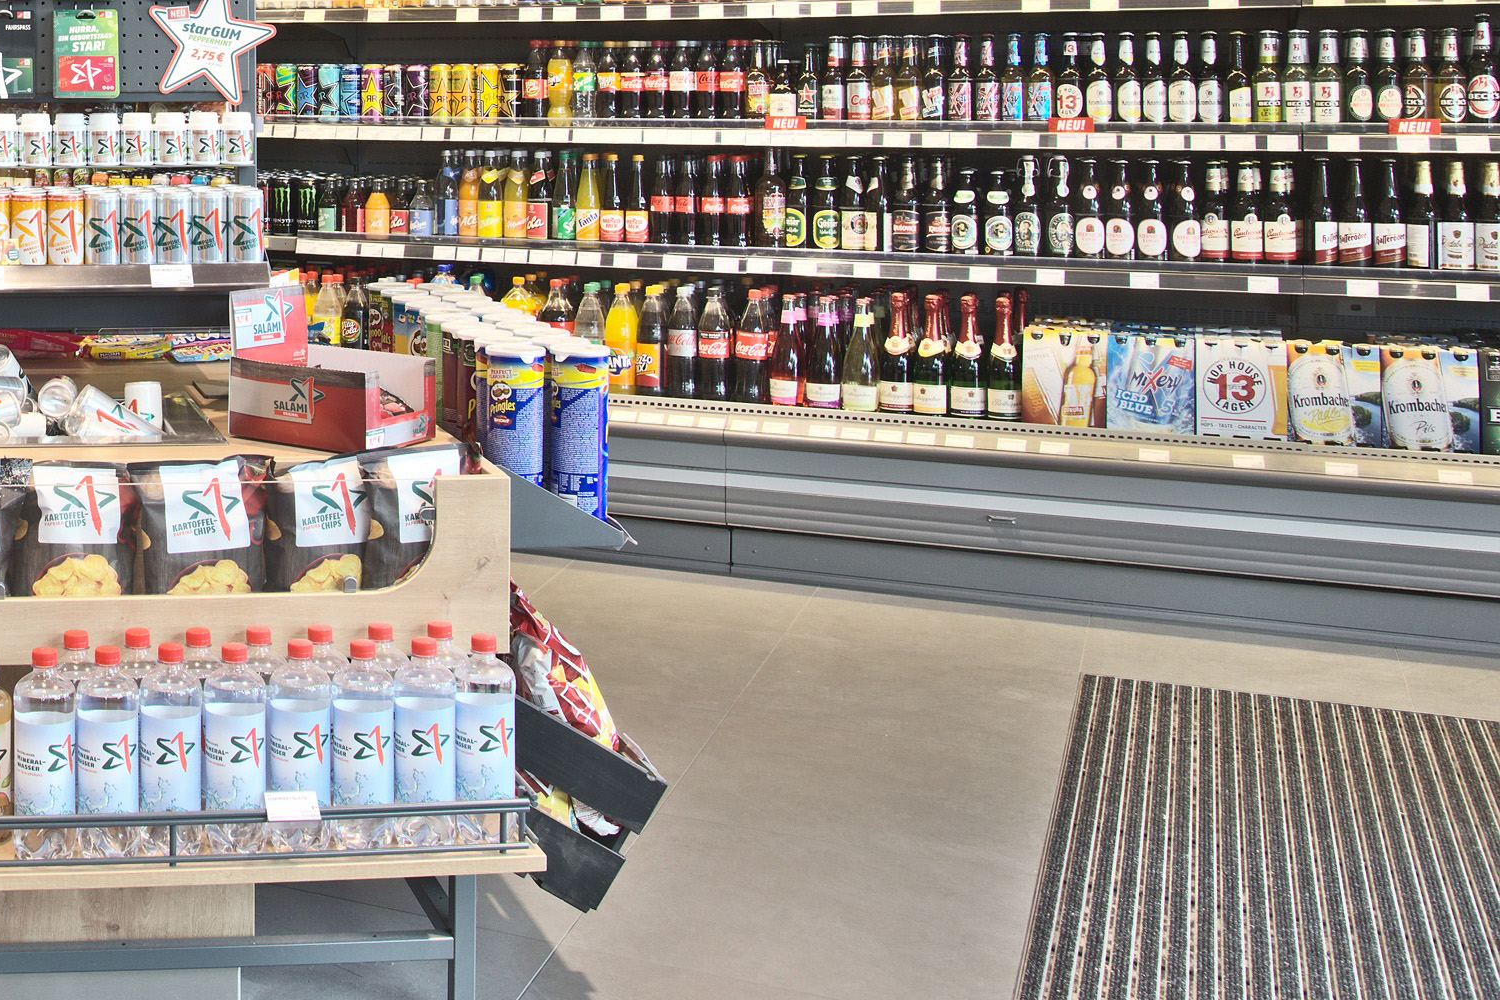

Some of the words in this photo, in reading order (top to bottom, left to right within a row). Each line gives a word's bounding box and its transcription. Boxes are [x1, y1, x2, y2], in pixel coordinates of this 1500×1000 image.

[170, 8, 186, 18] NEU
[69, 25, 99, 35] HURRA,
[181, 22, 242, 41] starGUM
[69, 33, 115, 42] GEBURTSTAGS-
[187, 34, 233, 48] PEPPERMINT
[71, 41, 106, 53] STAR!
[1063, 44, 1075, 53] 13
[190, 48, 216, 61] 2,75
[620, 78, 644, 89] oca-Cola
[1057, 93, 1077, 110] 13
[1468, 91, 1500, 101] BECK'S
[1056, 119, 1086, 131] NEU!
[1398, 121, 1431, 133] NEU!
[370, 219, 384, 229] ACE
[460, 213, 478, 226] ACE
[578, 212, 599, 228] Fanta
[239, 242, 260, 251] ENERGY
[252, 320, 282, 335] SALAMI
[341, 326, 359, 338] Cola
[735, 341, 767, 357] Coca-Cola
[608, 355, 632, 370] ANTA
[1206, 363, 1224, 385] HOP
[1229, 360, 1264, 387] HOUSE
[1215, 373, 1256, 397] 13
[1115, 388, 1149, 404] ICED
[1293, 392, 1350, 408] Krombacher
[273, 400, 309, 414] SALAMI
[489, 399, 516, 418] Pringles
[1118, 400, 1153, 415] BLUE
[1215, 397, 1255, 412] LAGER
[1388, 397, 1448, 415] Krombacher
[1307, 406, 1346, 424] Radler
[1411, 419, 1436, 436] Pils
[44, 510, 91, 523] KARTOFFEL-
[64, 517, 88, 529] CHIPS
[301, 510, 344, 527] KARTOFFEL-
[43, 520, 65, 528] PAPRIKA
[171, 517, 219, 533] KARTOFFEL-
[193, 523, 217, 536] CHIPS
[302, 523, 321, 532] PAPRIKA
[320, 518, 343, 531] CHIPS
[173, 530, 193, 538] PAPRIKA
[17, 755, 47, 766] MINERAL-
[17, 761, 41, 772] WASSER
